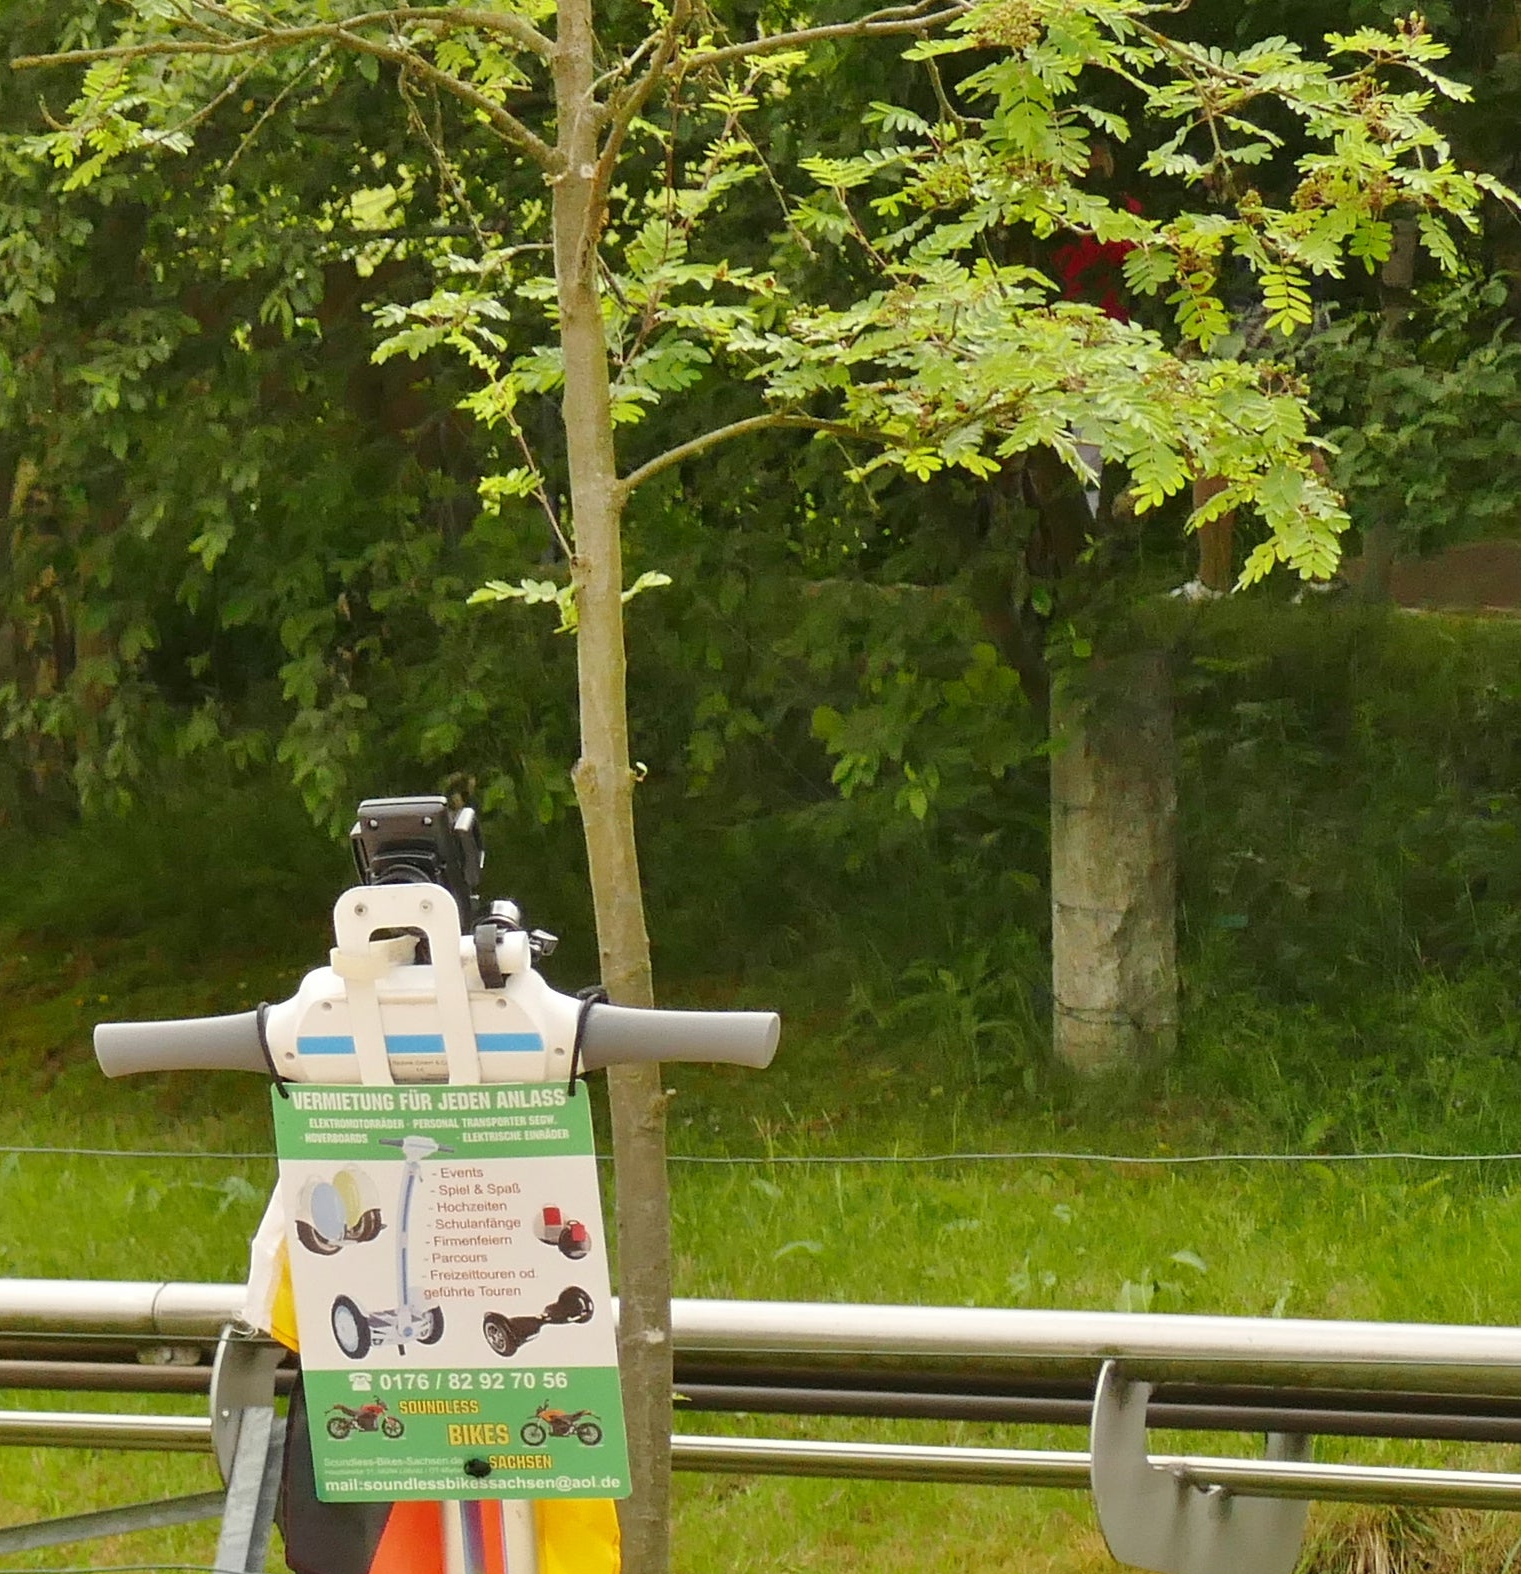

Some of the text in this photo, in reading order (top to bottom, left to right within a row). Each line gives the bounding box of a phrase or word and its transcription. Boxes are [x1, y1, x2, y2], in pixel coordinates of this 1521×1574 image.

[292, 1088, 566, 1111] VERMIETUNG FÜR JEDEN ANLASS
[413, 1117, 459, 1129] PERSONAL
[462, 1116, 526, 1128] TRANSPORTER
[305, 1133, 368, 1144] HOVERBOARDS
[463, 1128, 569, 1143] ELEKTRISCHE EINRÄDER
[441, 1168, 484, 1178] Events
[439, 1183, 521, 1197] Spiel & Spaß
[437, 1202, 507, 1213] Hochzeiten
[435, 1218, 521, 1231] Schulanfänge
[433, 1235, 512, 1247] Firmenfeiern
[432, 1253, 488, 1263] Parcours
[430, 1269, 516, 1281] Freizeittouren
[424, 1286, 521, 1300] geführte Touren
[380, 1373, 430, 1390] 0176
[448, 1373, 473, 1389] 82
[479, 1373, 505, 1389] 92
[511, 1372, 536, 1389] 70
[542, 1371, 568, 1388] 56
[399, 1400, 479, 1415] SOUNDLESS
[447, 1423, 510, 1446] BIKES
[488, 1455, 553, 1470] SACHSEN
[325, 1476, 620, 1492] mail:soundlessbikessachsen@aol.de
